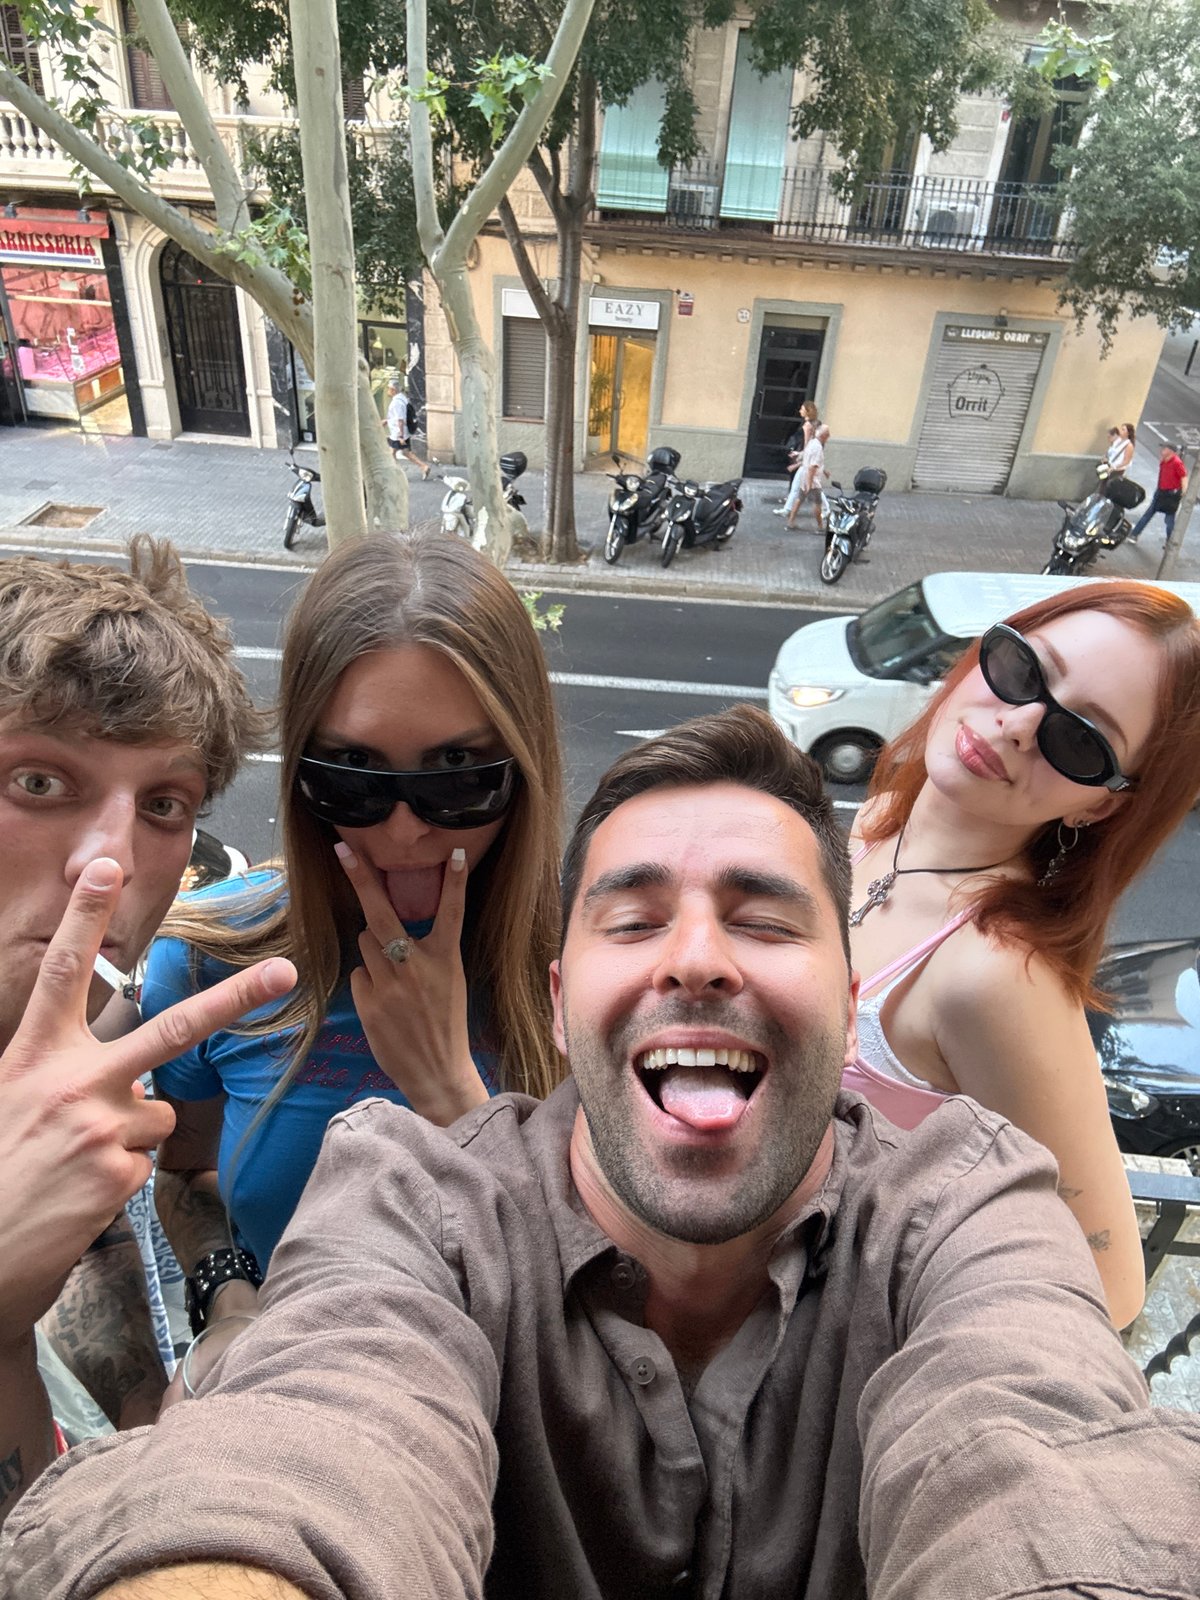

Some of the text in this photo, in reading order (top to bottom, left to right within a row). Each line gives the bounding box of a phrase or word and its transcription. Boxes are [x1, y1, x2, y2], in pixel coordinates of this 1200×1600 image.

[605, 302, 644, 317] EAZY
[1003, 332, 1031, 343] ORRIT
[955, 395, 988, 412] Orrit
